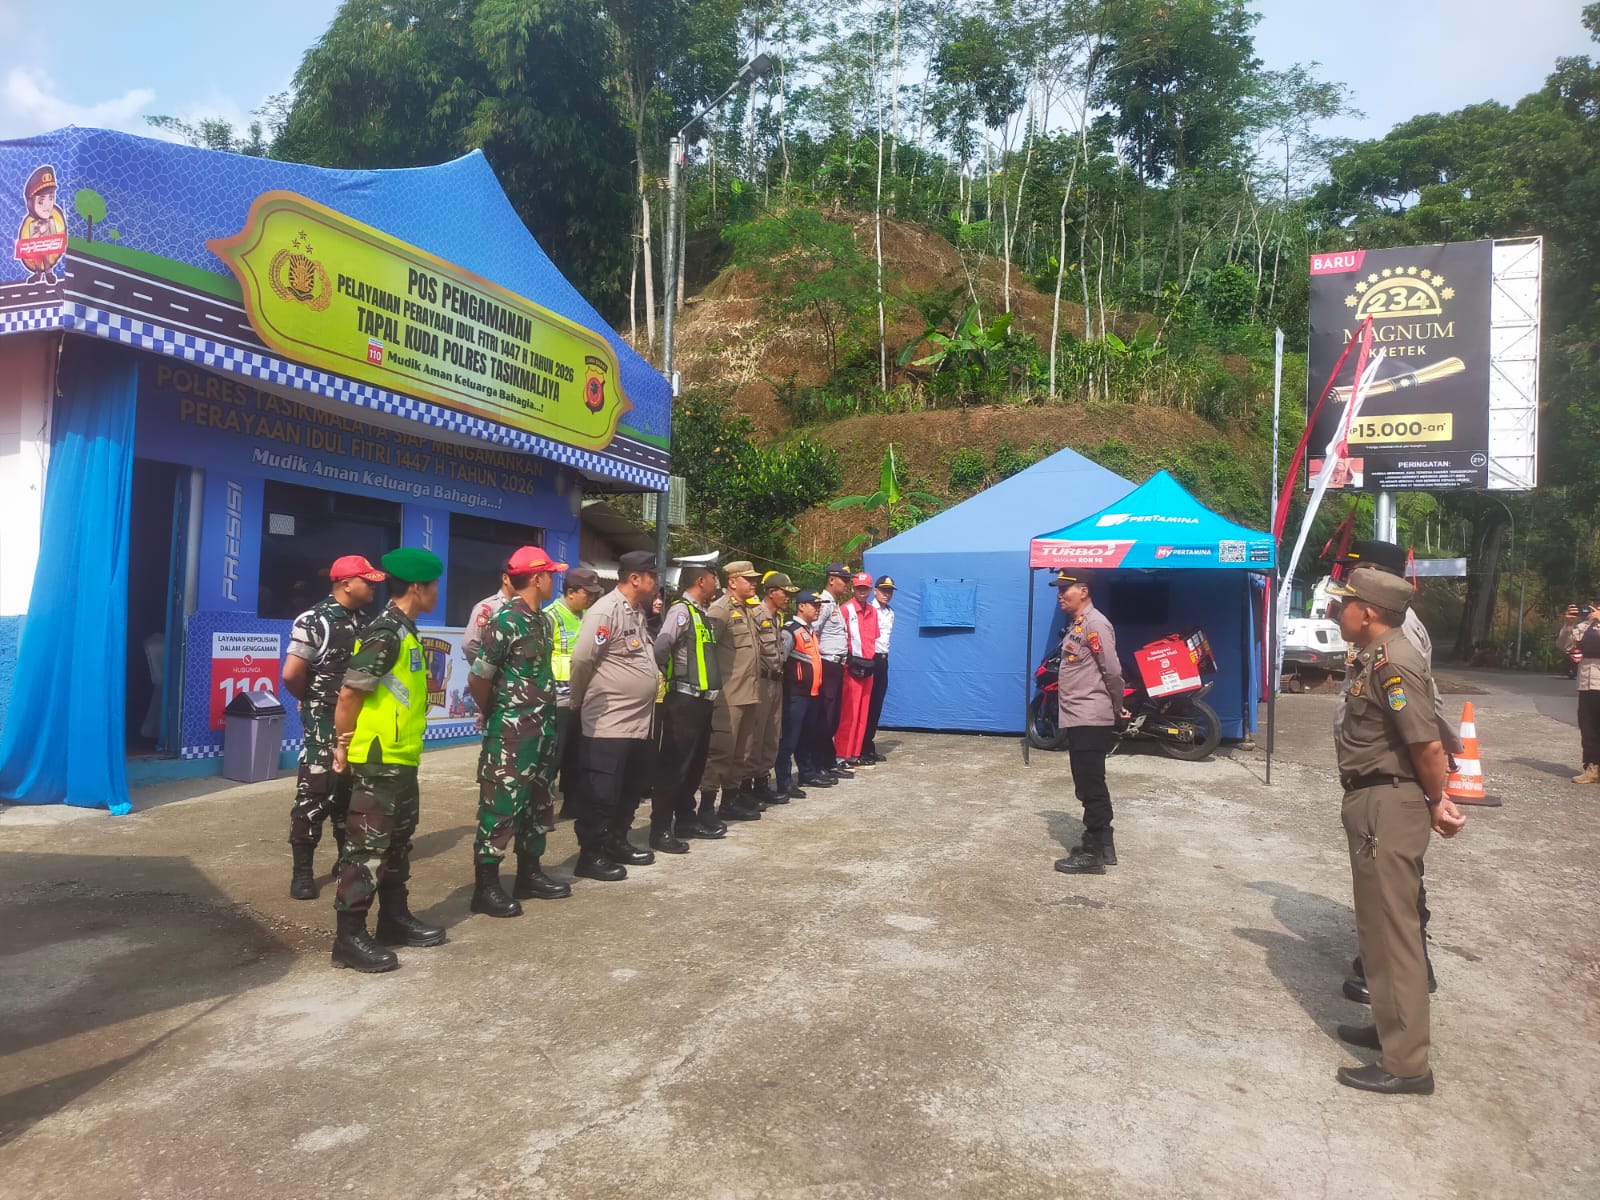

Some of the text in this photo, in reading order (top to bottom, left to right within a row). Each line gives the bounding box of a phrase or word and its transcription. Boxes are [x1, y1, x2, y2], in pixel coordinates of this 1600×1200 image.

[1313, 256, 1355, 270] BARU
[408, 267, 532, 344] POS PENGAMANAN
[1367, 287, 1430, 313] 234
[337, 273, 400, 315] PELAYANAN
[403, 300, 453, 335] PERAYAAN
[456, 321, 475, 344] IDUL
[478, 329, 498, 353] FITRI
[501, 339, 520, 361] 1447
[522, 348, 528, 364] H
[530, 351, 554, 375] TAHUN
[555, 362, 574, 383] 2026
[357, 306, 400, 345] TAPAL
[404, 324, 439, 359] KUDA
[442, 338, 487, 375] POLRES
[491, 357, 559, 402] TASIKMALAYA
[369, 349, 381, 361] 110
[387, 351, 421, 371] Mudik
[423, 364, 452, 382] Aman
[454, 374, 498, 397] Keluarga
[157, 364, 247, 405] POLRES
[180, 399, 534, 496] PERAYAAN IDUL FITRI 1447 H TAHUN 2026
[252, 448, 309, 473] Mudik
[312, 461, 358, 482] Aman
[362, 470, 430, 497] Keluarga
[222, 480, 242, 602] PRESISI
[1128, 515, 1199, 524] PERTAMINA
[1042, 547, 1101, 556] TURBO
